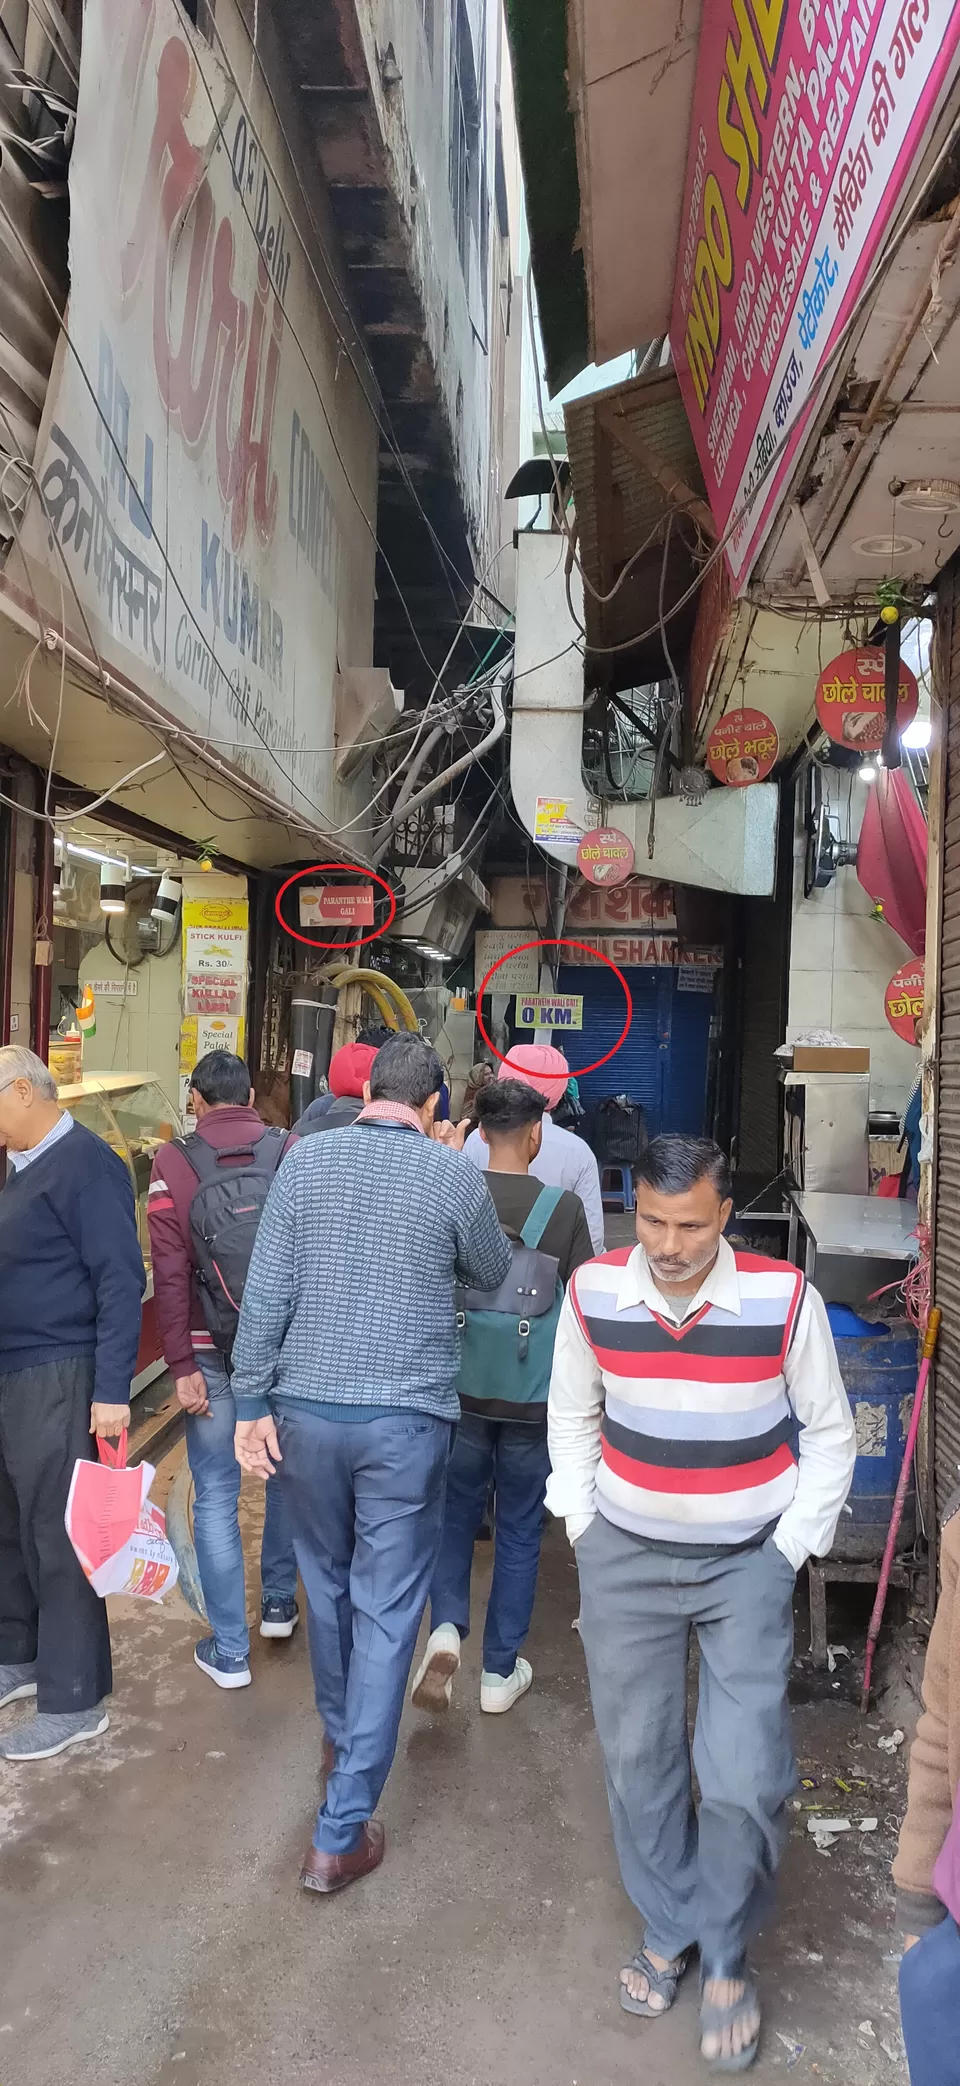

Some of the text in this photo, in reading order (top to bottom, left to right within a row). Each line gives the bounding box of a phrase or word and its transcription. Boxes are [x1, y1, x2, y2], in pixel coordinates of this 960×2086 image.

[867, 60, 896, 147] की
[256, 166, 291, 306] Delhi
[707, 340, 741, 459] SHERWANI,
[734, 260, 756, 343] INDO
[751, 56, 807, 265] WESTERN,
[760, 206, 814, 376] WHOLESALE
[809, 172, 823, 210] &
[685, 174, 733, 413] INDO
[713, 384, 747, 489] LEHANGA,
[741, 262, 779, 382] CHUNNI,
[771, 117, 813, 264] KURTA
[96, 318, 154, 538] RAJ
[201, 518, 285, 694] KUMAR
[174, 613, 224, 700] Corner
[822, 675, 859, 704] छोले
[709, 737, 741, 760] छोले
[580, 844, 629, 860] छोले चावल
[190, 932, 242, 941] STICK KULFI
[198, 959, 233, 968] Rs. 30/-
[190, 975, 238, 986] SPECIAL
[192, 988, 236, 1000] KULLAD
[197, 1001, 230, 1013] LASSI
[540, 1008, 578, 1025] KM.
[202, 1030, 233, 1040] Special
[203, 1041, 230, 1050] Palak
